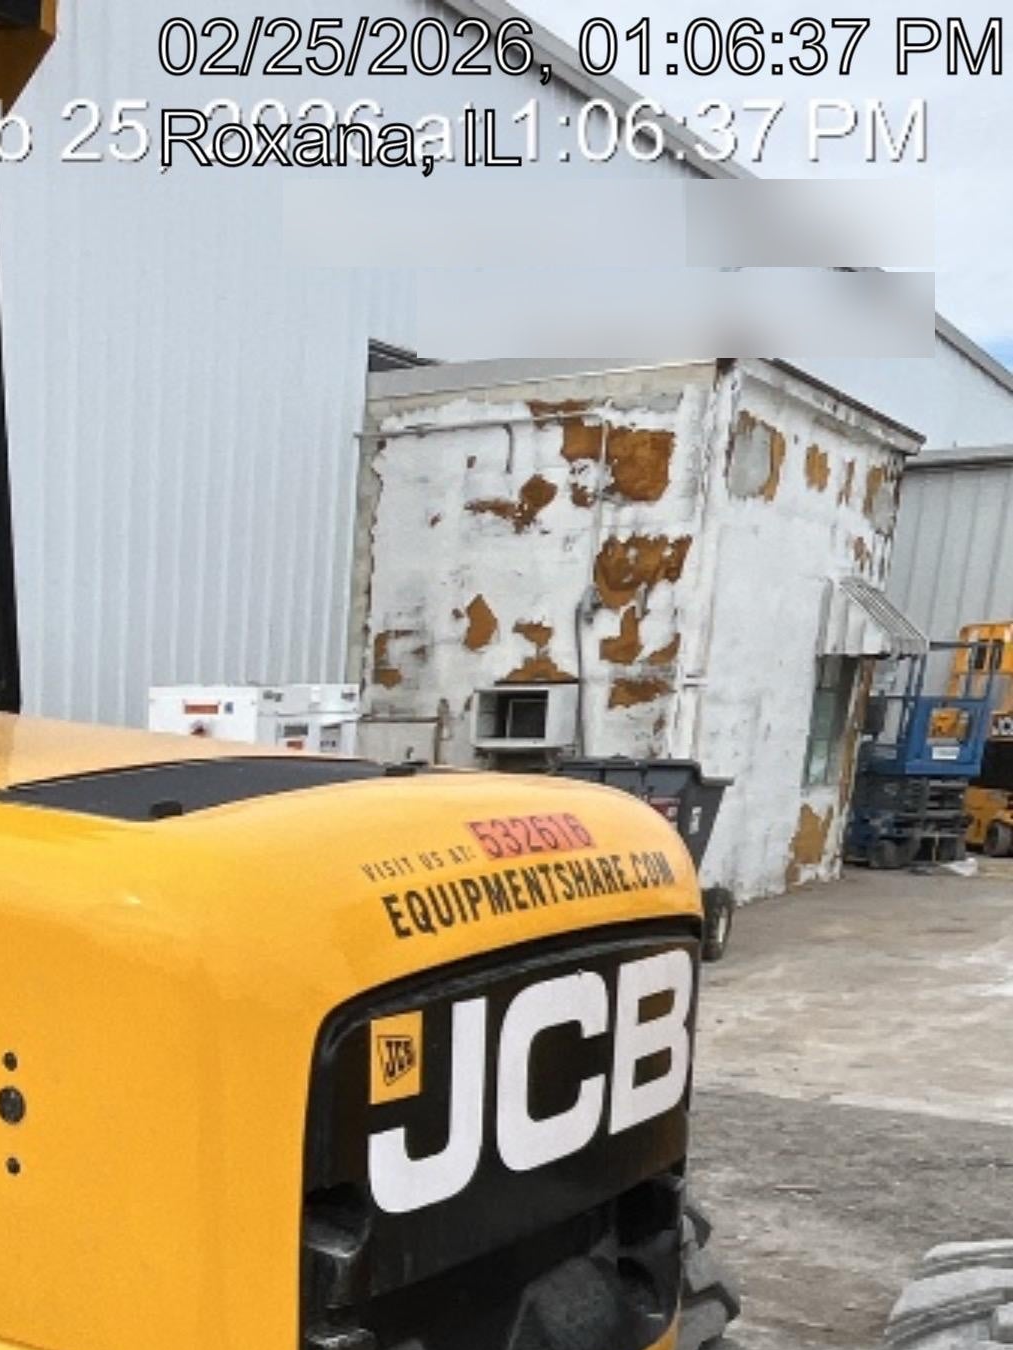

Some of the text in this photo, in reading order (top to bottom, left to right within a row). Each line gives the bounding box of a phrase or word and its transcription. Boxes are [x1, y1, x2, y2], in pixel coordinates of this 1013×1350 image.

[469, 814, 593, 859] 532616
[361, 845, 477, 882] VISIT US AT:
[383, 851, 675, 939] EQUIPMENTSHARE.COM
[368, 949, 692, 1214] JCB
[385, 1040, 416, 1078] JCB
